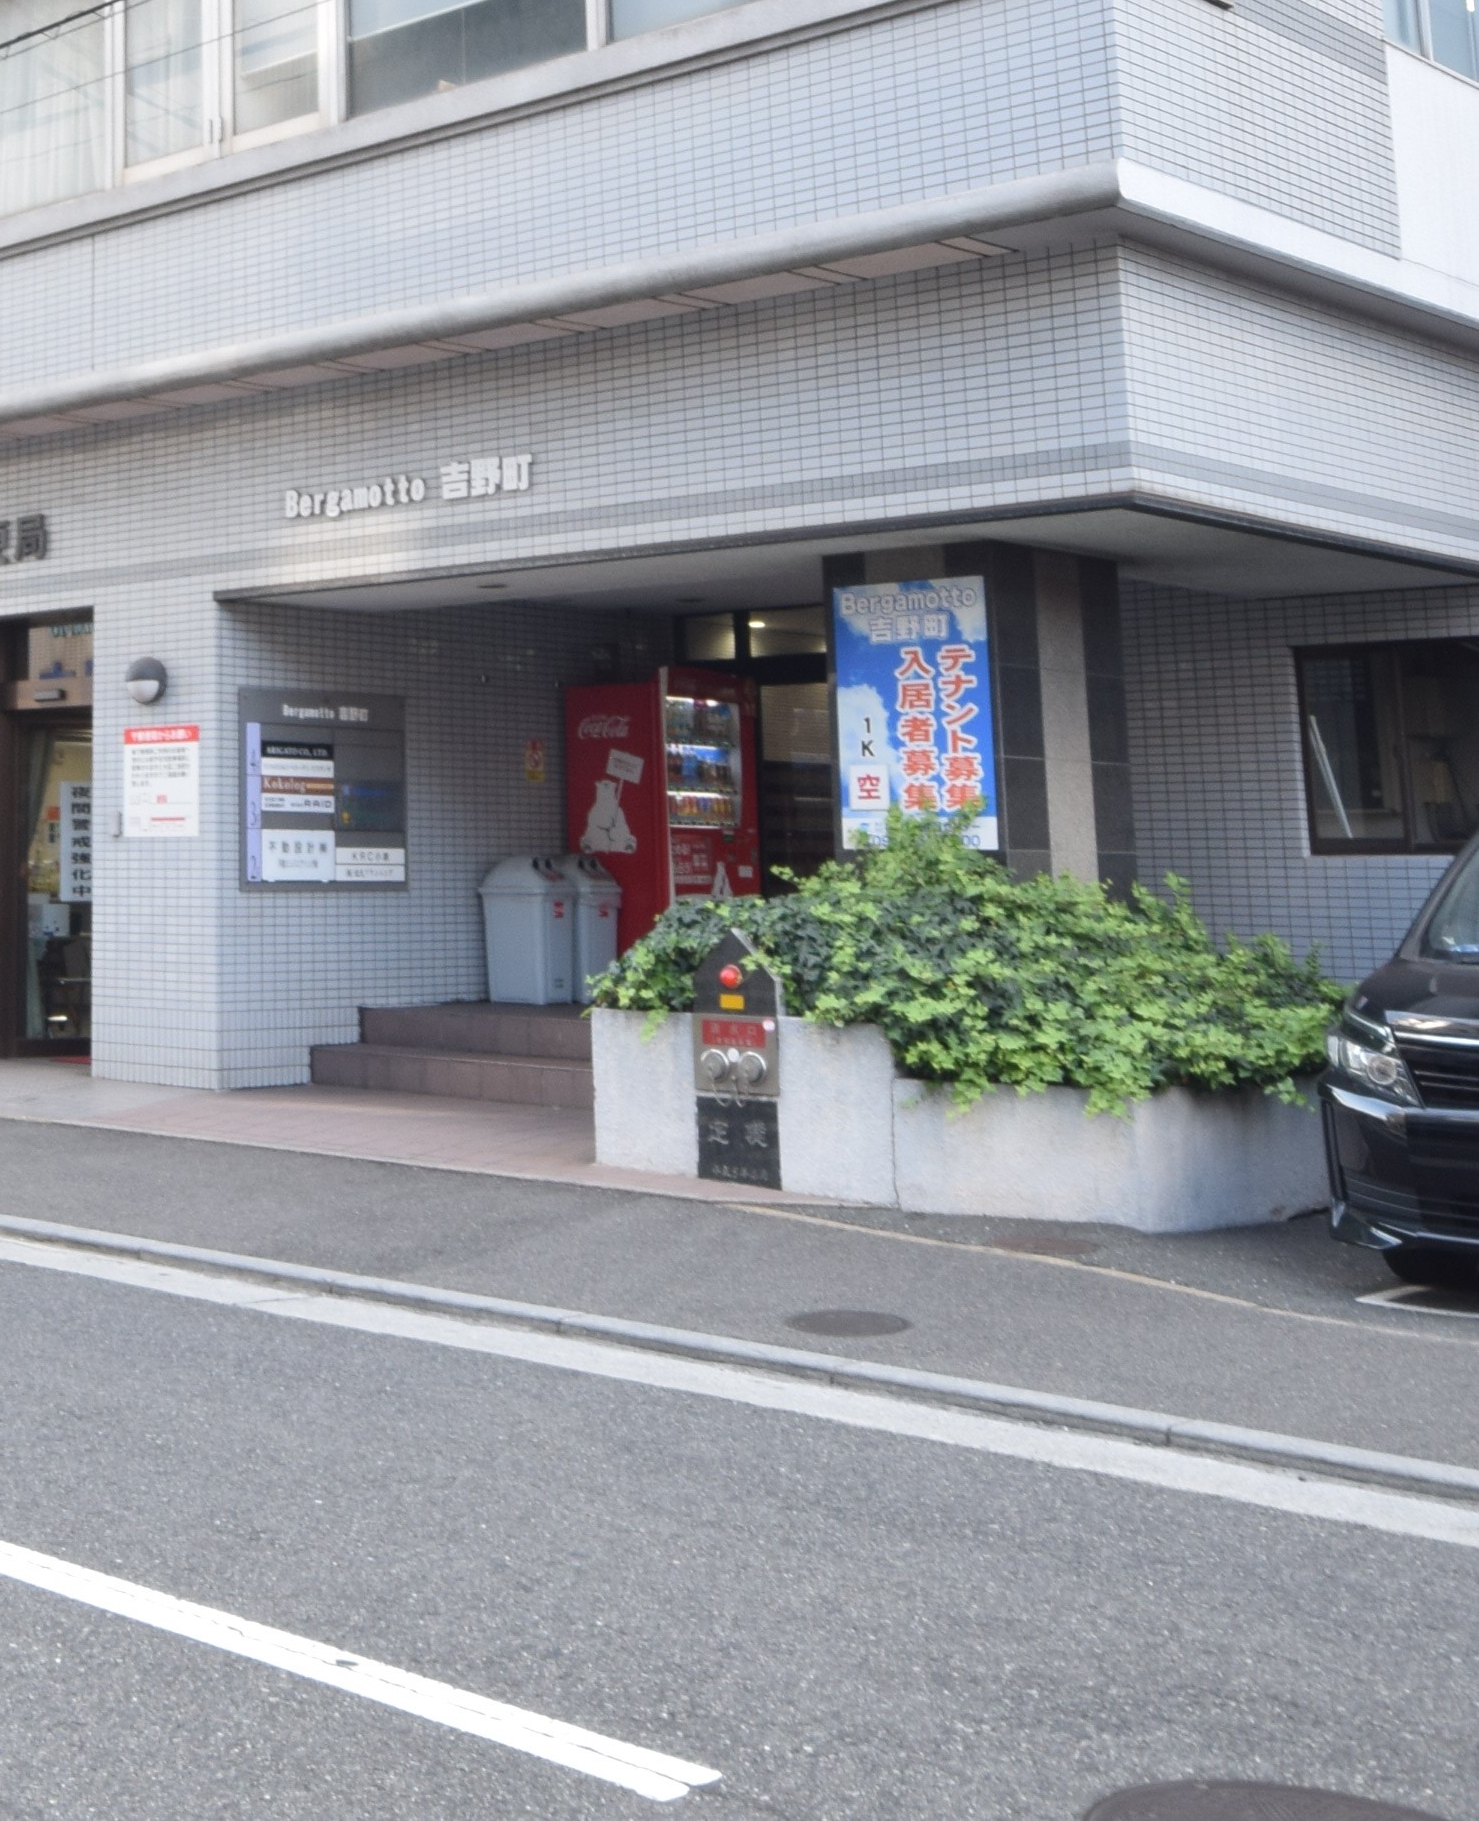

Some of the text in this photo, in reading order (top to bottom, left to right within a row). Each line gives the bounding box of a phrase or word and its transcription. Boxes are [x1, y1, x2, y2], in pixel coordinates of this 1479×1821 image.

[285, 454, 532, 518] Bergamotto 吉野町
[840, 587, 977, 616] Bergamotto
[869, 612, 950, 643] 吉野町
[894, 646, 939, 811] 入居者募集
[939, 645, 982, 812] テナント募集
[856, 774, 882, 801] 空
